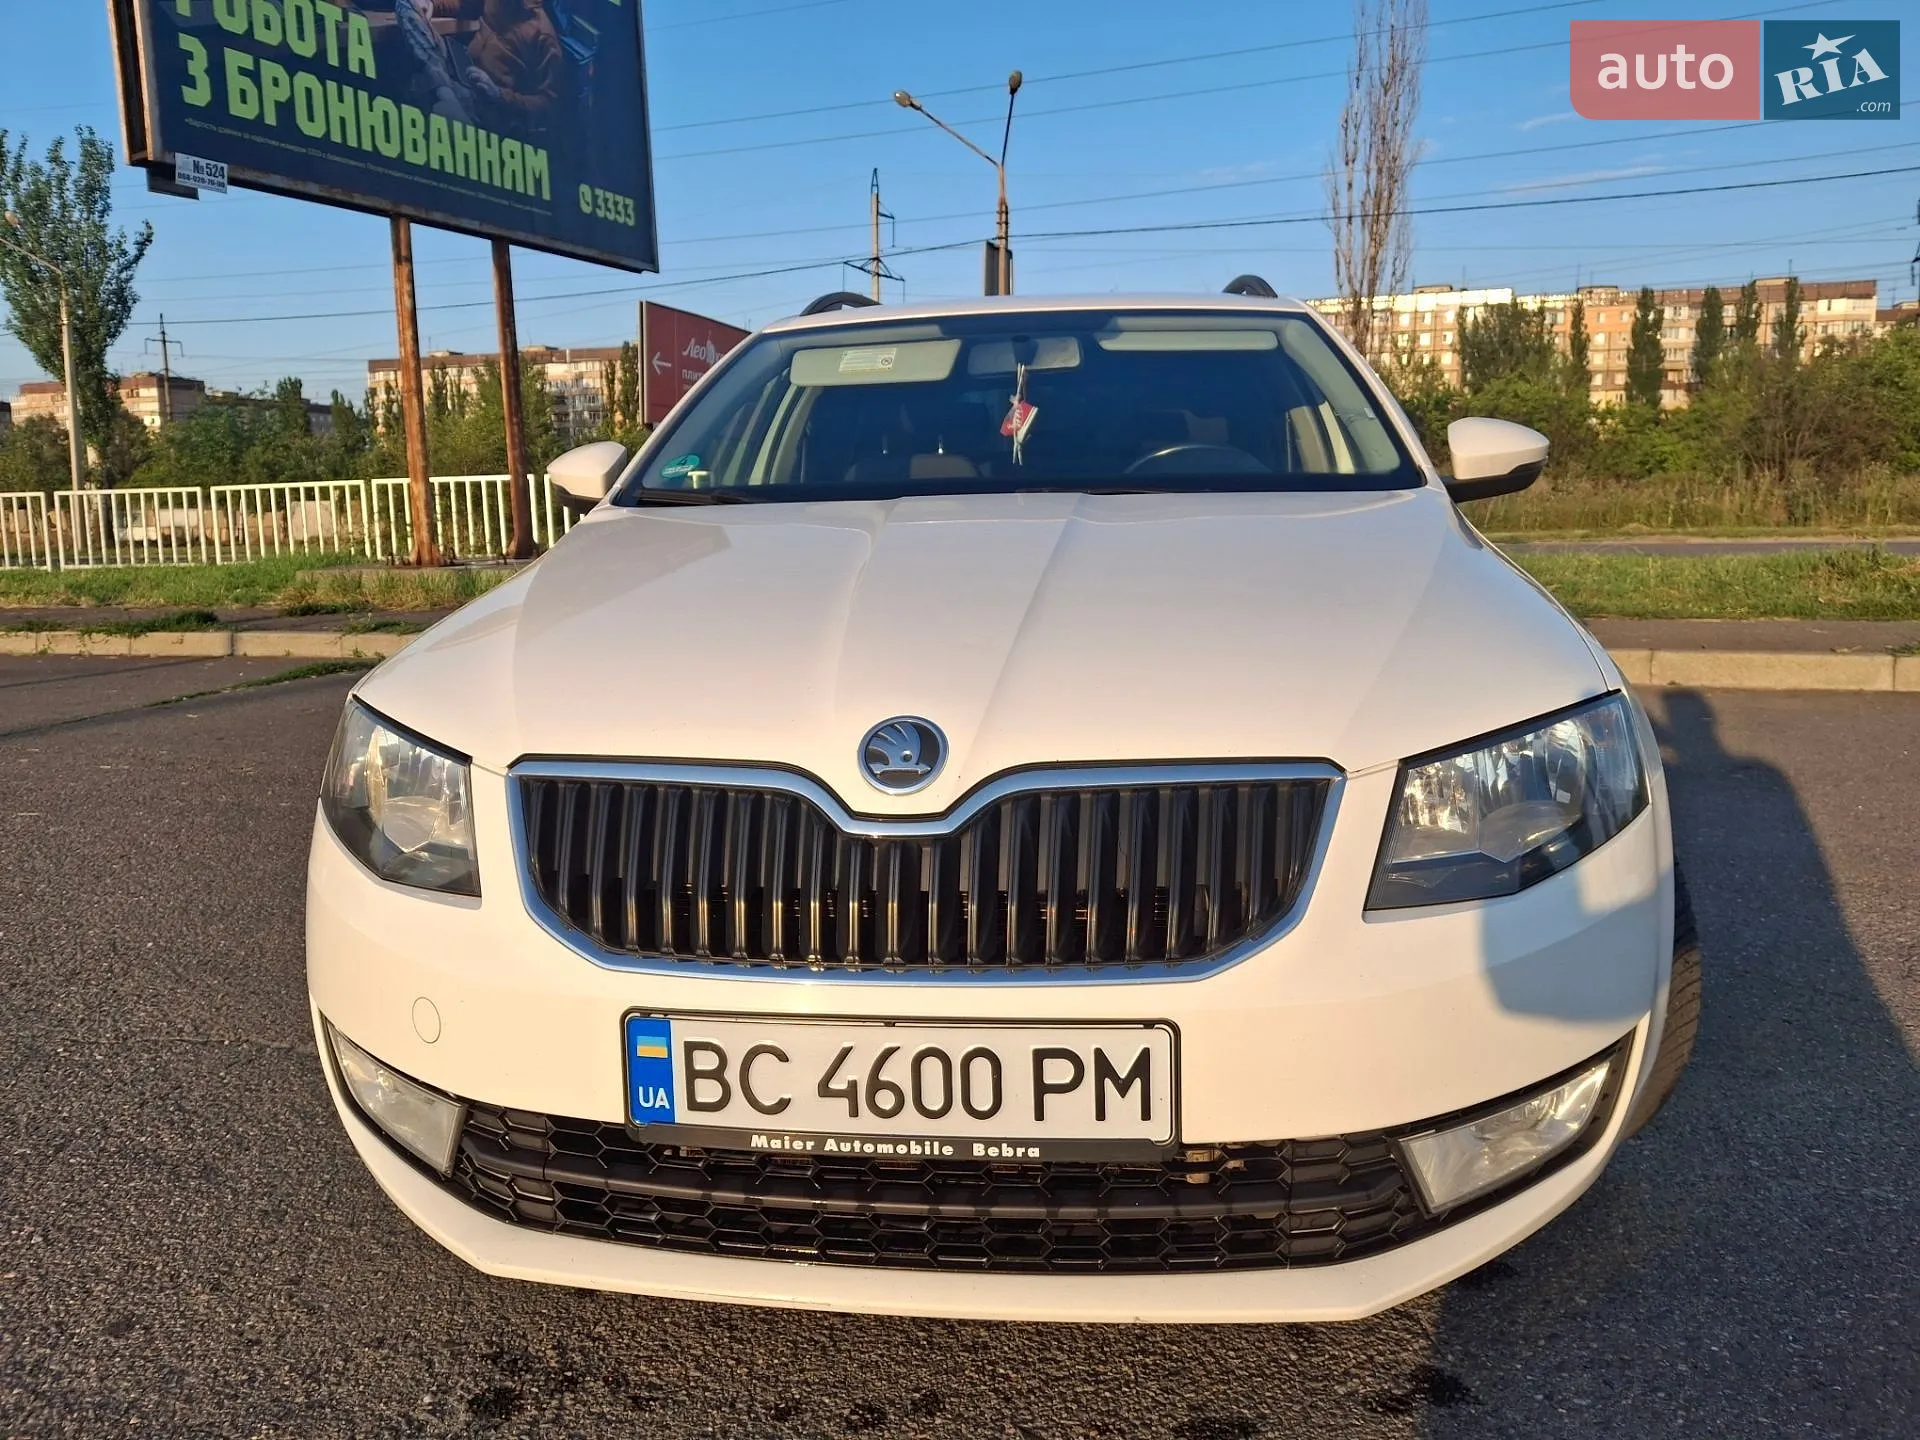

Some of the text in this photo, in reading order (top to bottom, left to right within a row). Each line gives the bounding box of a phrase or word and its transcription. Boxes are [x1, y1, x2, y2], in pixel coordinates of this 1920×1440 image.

[175, 0, 377, 80] ОБОТА
[223, 46, 551, 201] БРОНЮВАННЯМ
[638, 1086, 670, 1110] UA
[683, 1040, 1152, 1122] BC 4600 PM
[750, 1135, 1041, 1159] Maier Automobile Bebra
